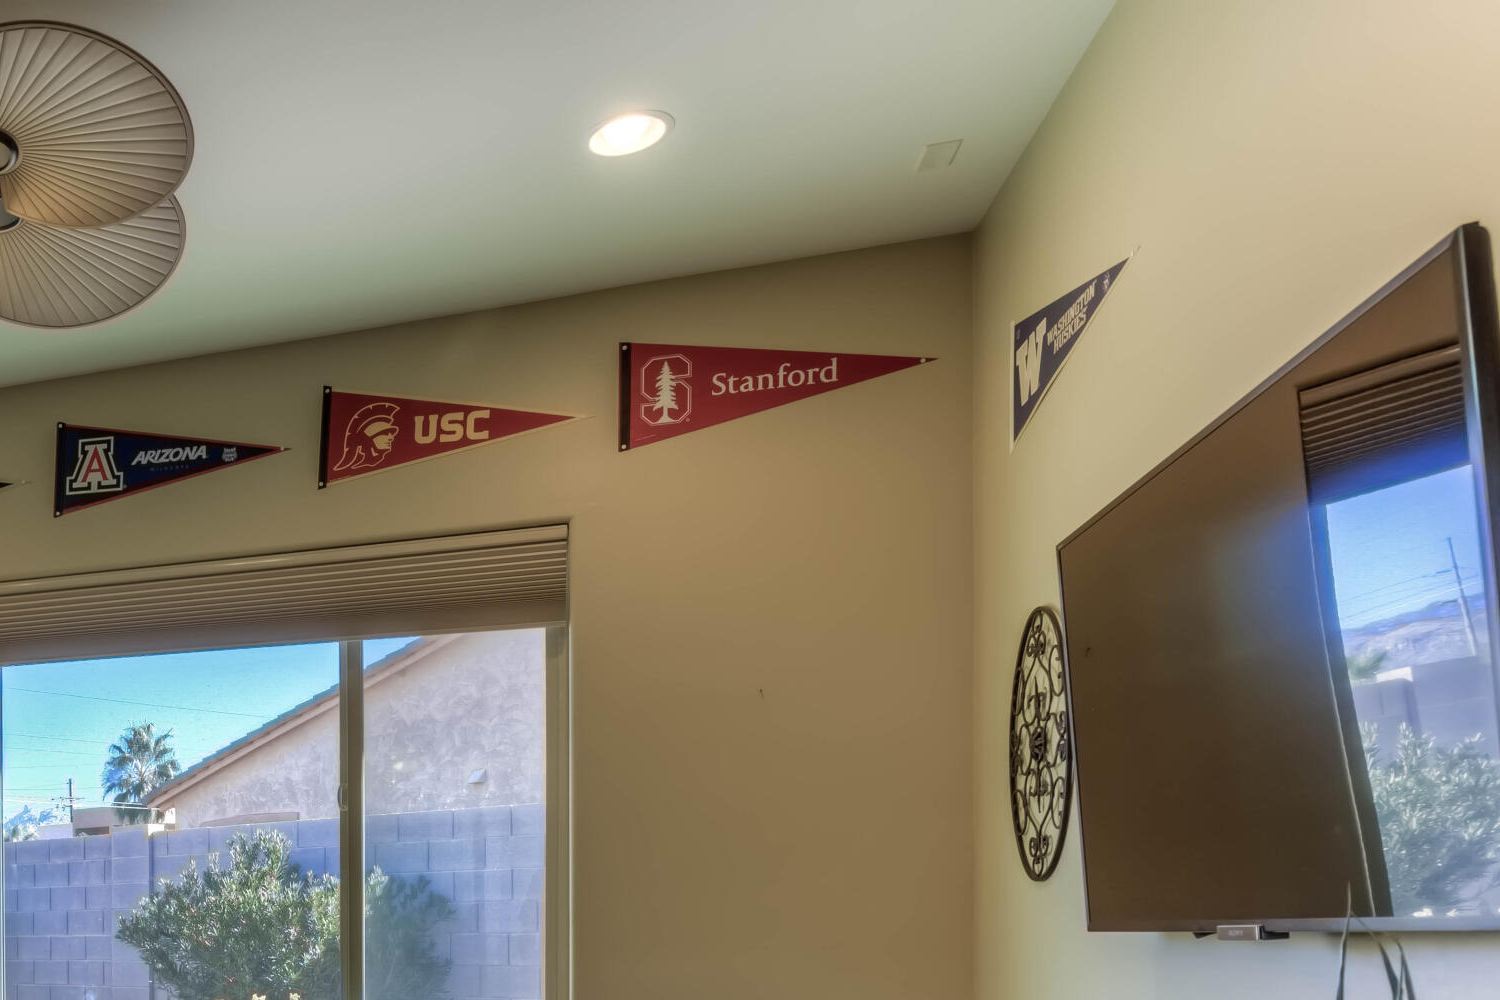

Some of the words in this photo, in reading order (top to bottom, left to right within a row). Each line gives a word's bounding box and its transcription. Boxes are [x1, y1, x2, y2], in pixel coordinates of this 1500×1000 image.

[1047, 279, 1098, 346] WASHINGTON
[1053, 306, 1089, 354] HUSKIES
[711, 356, 839, 396] Stanford
[1015, 317, 1047, 407] W
[414, 409, 491, 444] USC
[66, 436, 124, 495] A
[131, 445, 208, 466] ARIZONA
